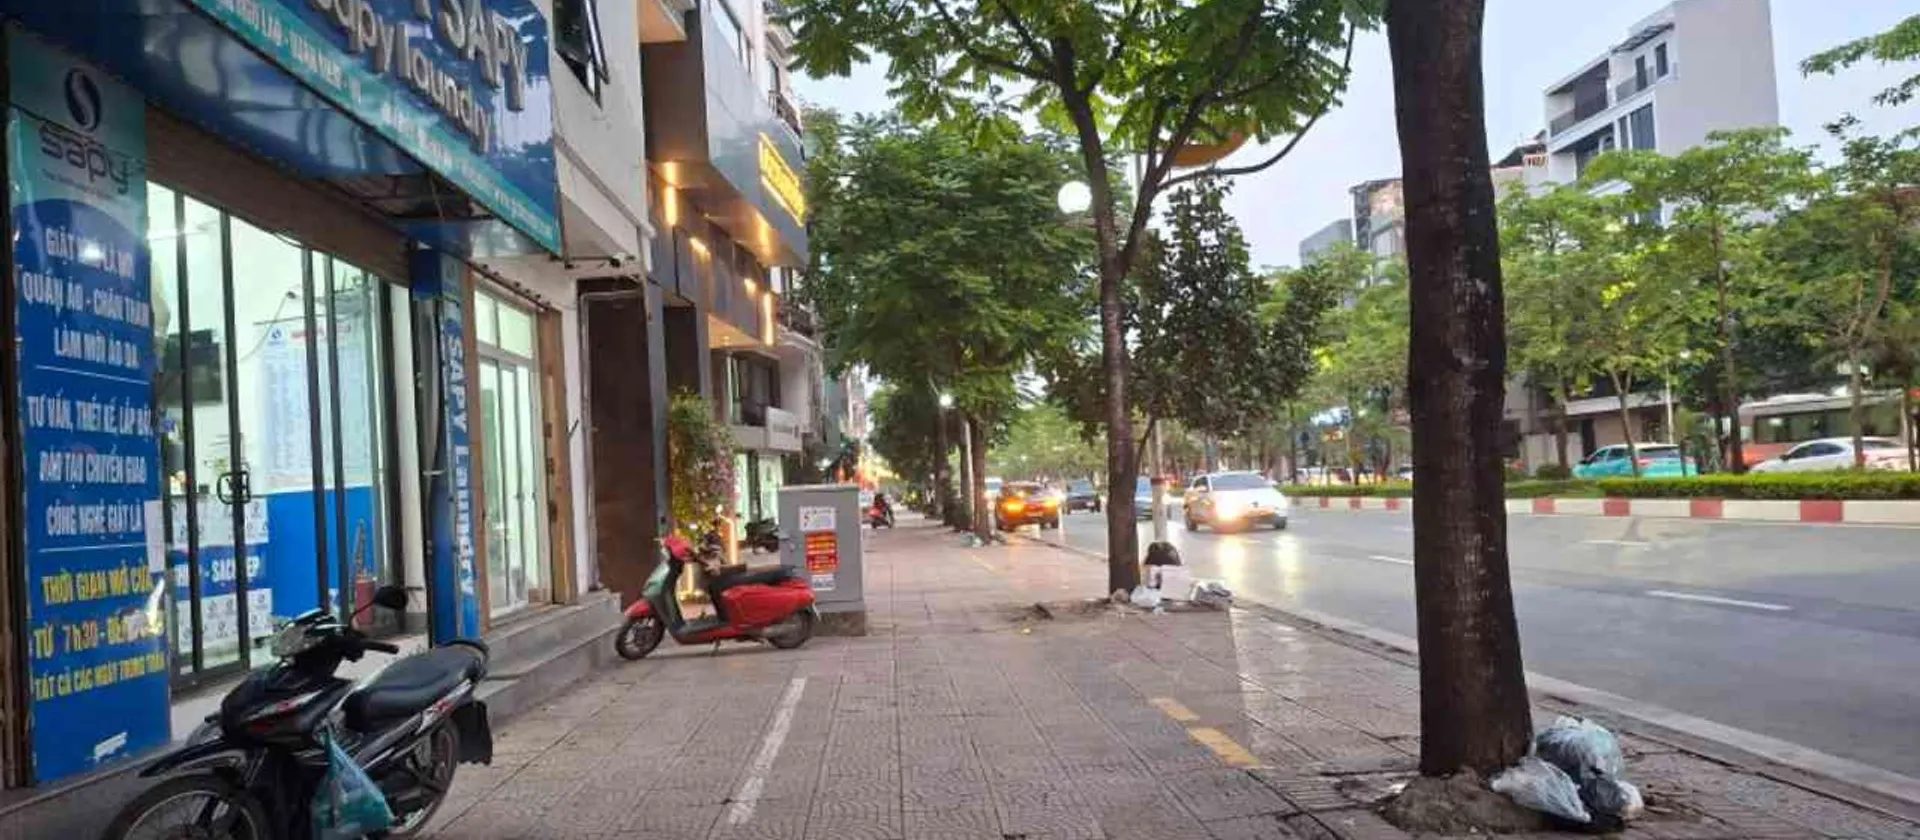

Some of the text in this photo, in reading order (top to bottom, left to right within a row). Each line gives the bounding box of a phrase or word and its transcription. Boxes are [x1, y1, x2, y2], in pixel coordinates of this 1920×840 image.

[304, 0, 394, 73] apy
[437, 0, 527, 112] SAPY
[39, 122, 130, 196] sapy
[54, 324, 82, 360] LÀM
[449, 334, 468, 434] SAPY
[211, 558, 239, 586] SẠC
